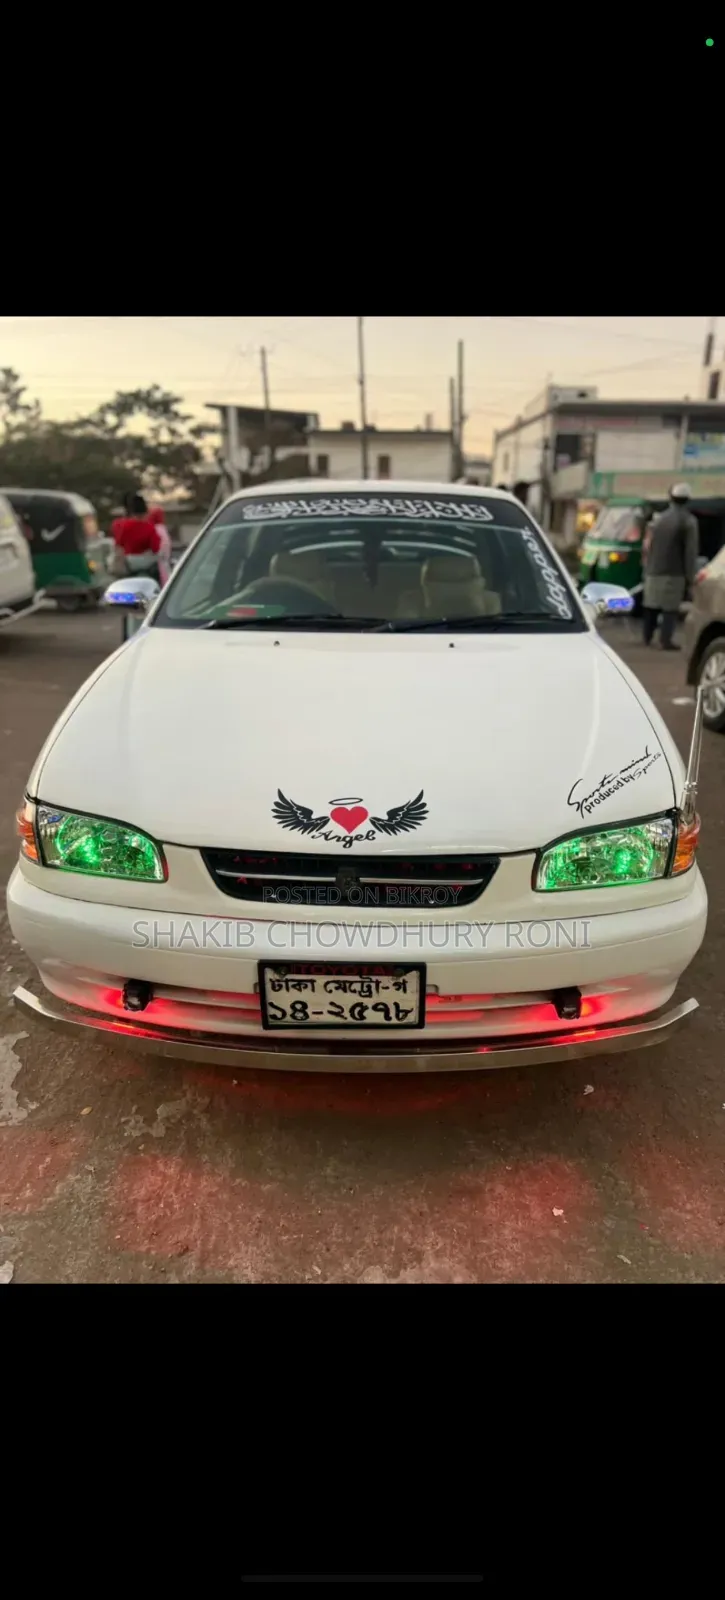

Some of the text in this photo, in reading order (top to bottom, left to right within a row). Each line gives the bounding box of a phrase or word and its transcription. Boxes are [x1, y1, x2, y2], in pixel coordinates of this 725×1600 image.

[584, 780, 625, 814] produced
[620, 772, 636, 785] by
[311, 829, 376, 849] Angel
[269, 977, 316, 994] ঢাকা
[267, 1000, 414, 1022] ১৪-২৫৭৮
